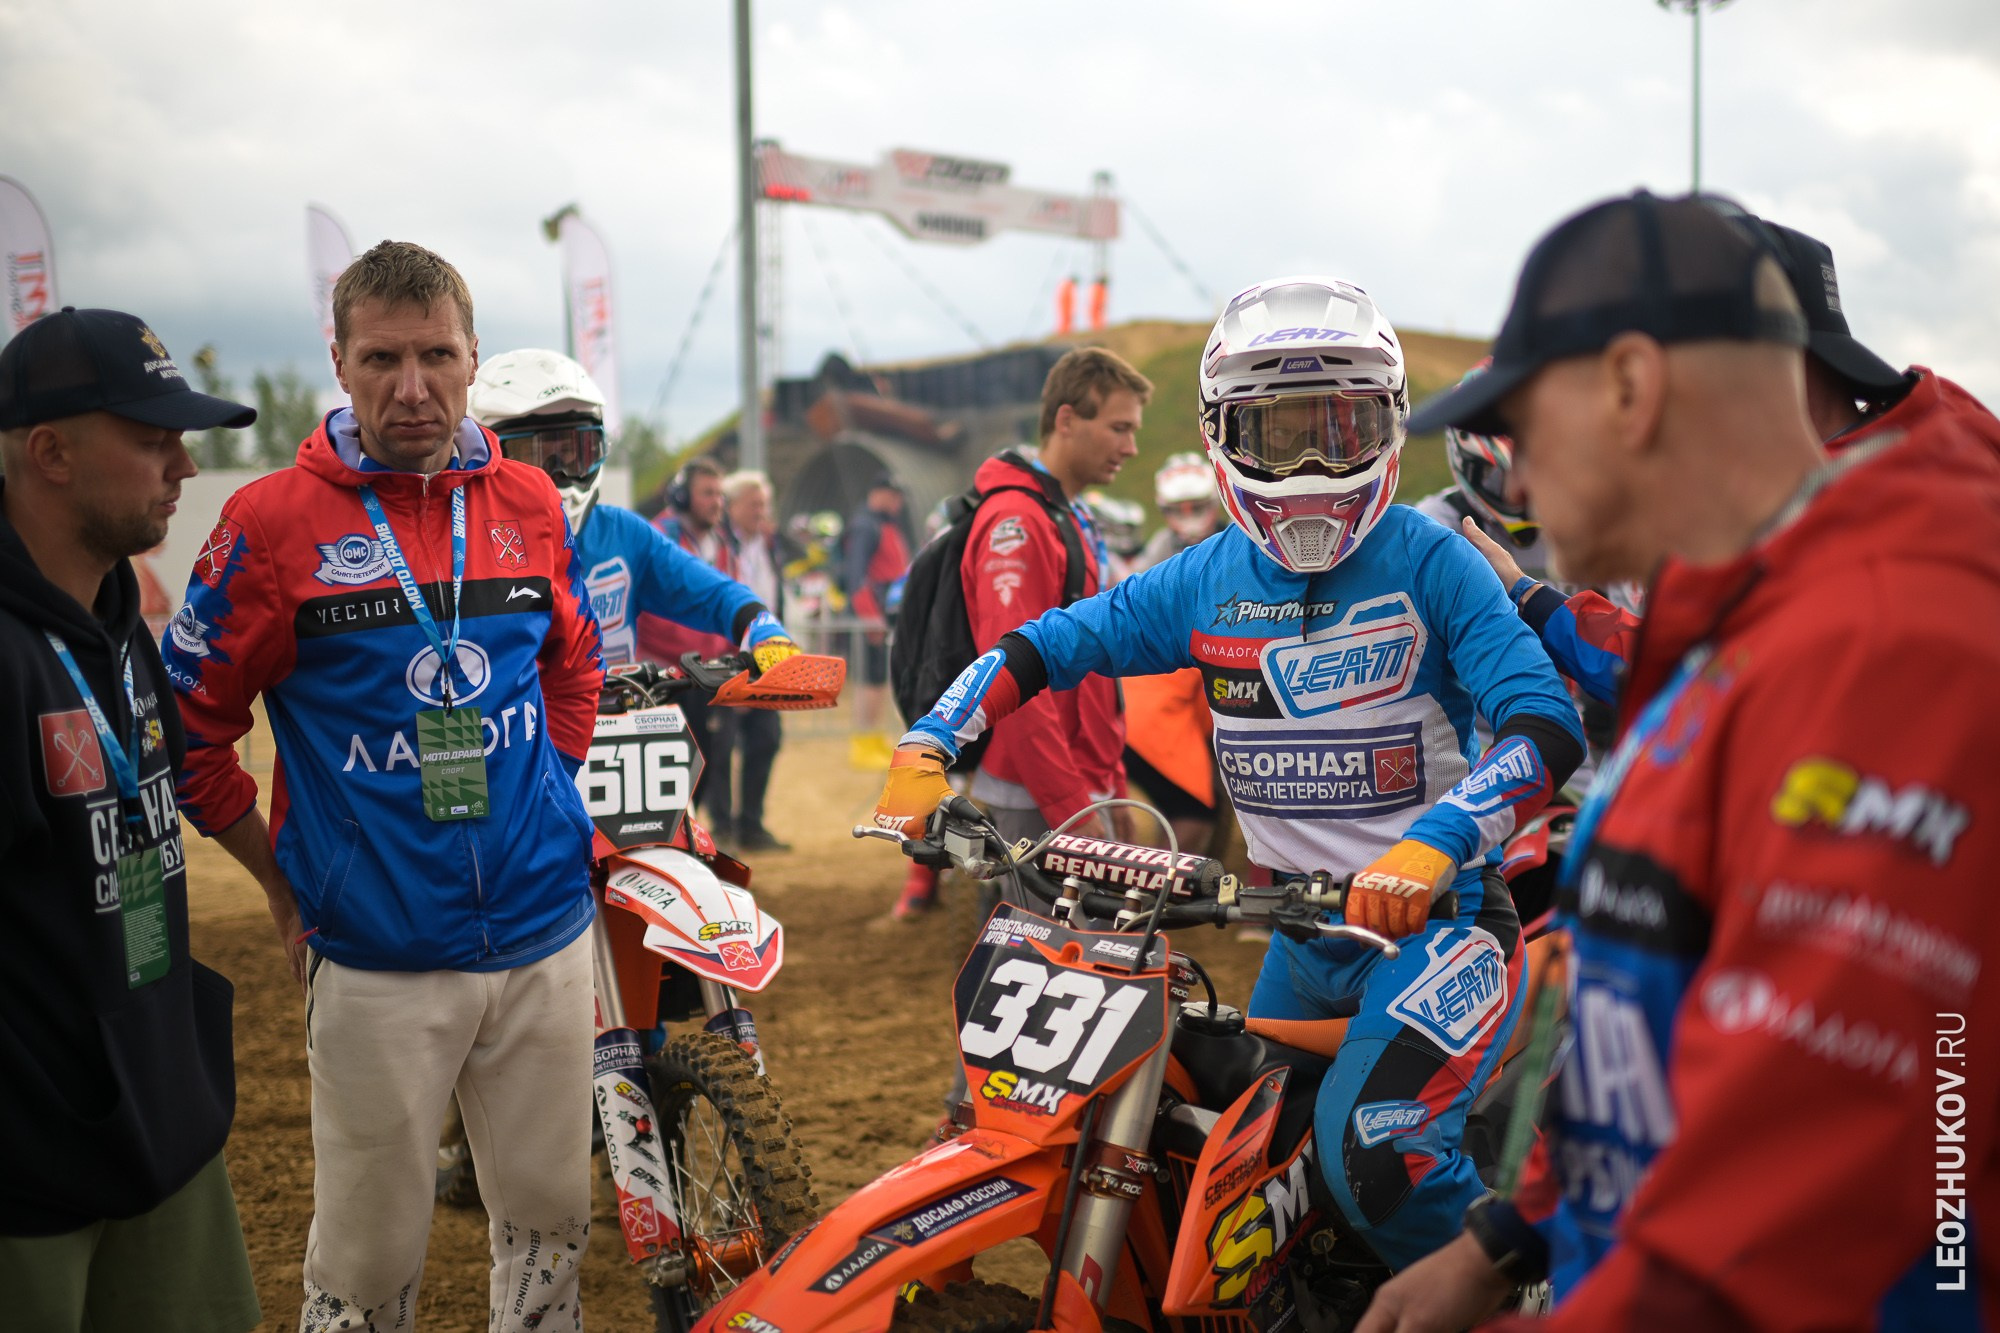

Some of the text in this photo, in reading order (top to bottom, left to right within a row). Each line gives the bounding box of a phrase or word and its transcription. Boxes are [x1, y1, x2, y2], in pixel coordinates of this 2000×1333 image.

[1248, 327, 1358, 347] LEATT
[1286, 360, 1315, 370] LEATT
[343, 546, 368, 560] ФМС
[331, 562, 386, 579] САНКТ-ПЕТЕРБУРГ
[395, 570, 424, 610] МОТО
[316, 599, 401, 624] VECTOR
[1210, 645, 1260, 659] ЛАДОГА
[1285, 635, 1415, 697] LEATT
[164, 664, 207, 696] АДОГА
[1212, 677, 1261, 703] SMX
[634, 715, 678, 725] СБОРНАЯ
[342, 701, 538, 773] ЛАОГА
[422, 751, 450, 762] МОТО
[1221, 751, 1367, 777] СБОРНАЯ
[441, 766, 465, 775] СПОРТ
[576, 740, 690, 817] 616
[1229, 776, 1373, 800] САНКТ-ПЕТЕРБУРГА
[1048, 833, 1195, 872] RENTHAL
[1043, 853, 1192, 896] RENTHAL
[1352, 871, 1430, 899] LEATT
[629, 878, 677, 910] ЛАДОГА
[699, 920, 753, 941] SMX
[987, 917, 1052, 941] СЕВОСТЬЯНОВ
[1418, 948, 1499, 1030] LEATT
[959, 958, 1149, 1086] 331
[594, 1046, 642, 1063] БОРНАЯ
[980, 1069, 1069, 1115] SMX
[1362, 1108, 1426, 1132] LEATT
[602, 1110, 620, 1175] ЛАДОГА
[911, 1179, 1012, 1233] ДОСААФ РОССИИ
[513, 1228, 541, 1317] SEEING THINGS
[842, 1242, 888, 1278] ЛАДОГА
